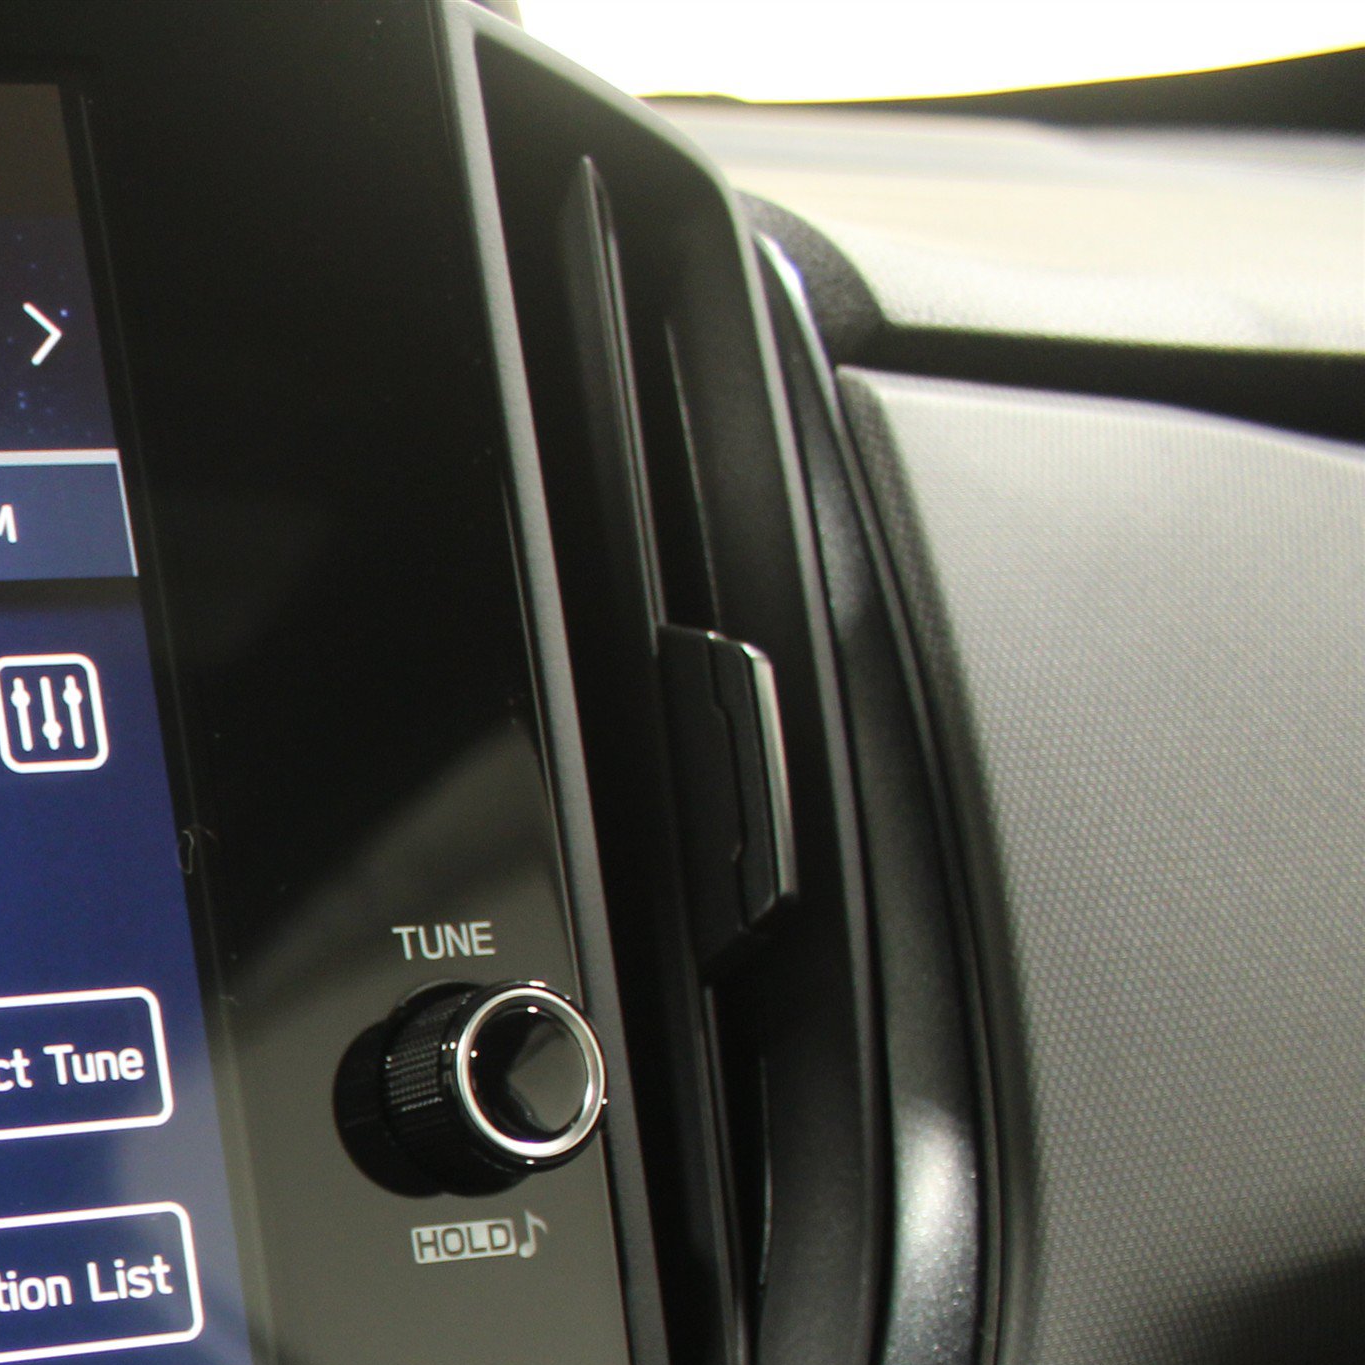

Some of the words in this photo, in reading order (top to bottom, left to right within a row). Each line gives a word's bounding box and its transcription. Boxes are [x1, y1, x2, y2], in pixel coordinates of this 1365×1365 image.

[391, 921, 496, 961] TUNE
[44, 1044, 145, 1086] Tune
[415, 1221, 513, 1261] HOLD
[86, 1256, 173, 1303] List
